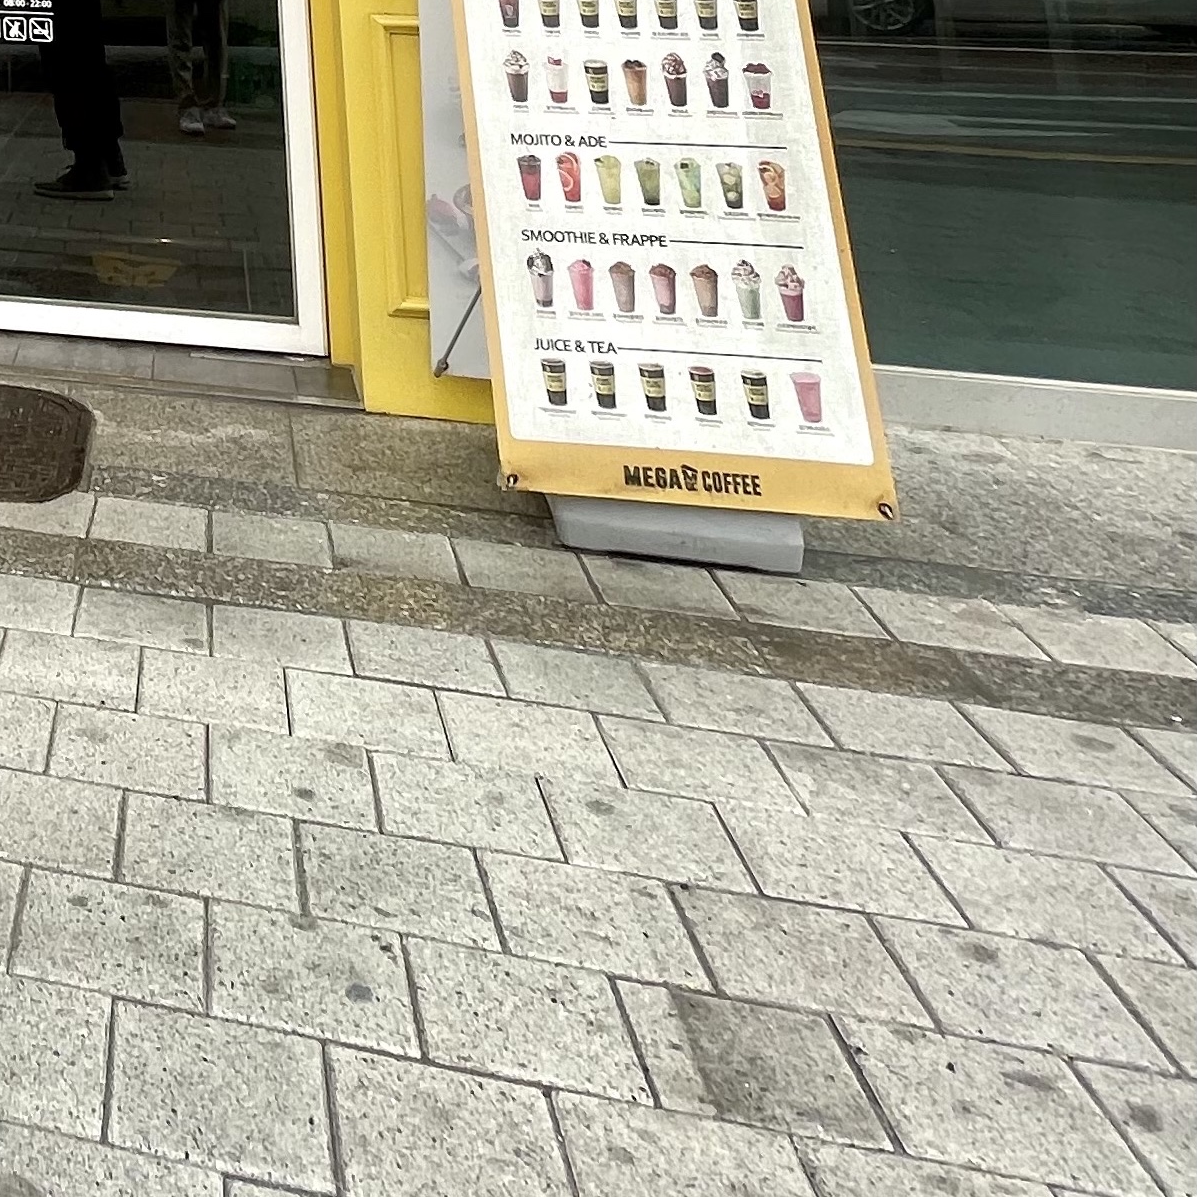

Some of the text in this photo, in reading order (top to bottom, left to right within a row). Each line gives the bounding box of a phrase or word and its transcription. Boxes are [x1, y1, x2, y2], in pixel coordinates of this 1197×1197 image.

[29, 0, 52, 8] 22:00
[510, 133, 608, 148] MOJITO & ADE
[521, 229, 669, 248] SMOOTHIE & FRAPPE
[533, 337, 618, 355] JUICE & TEA
[623, 464, 683, 490] MEGA
[701, 470, 762, 497] COFFEE
